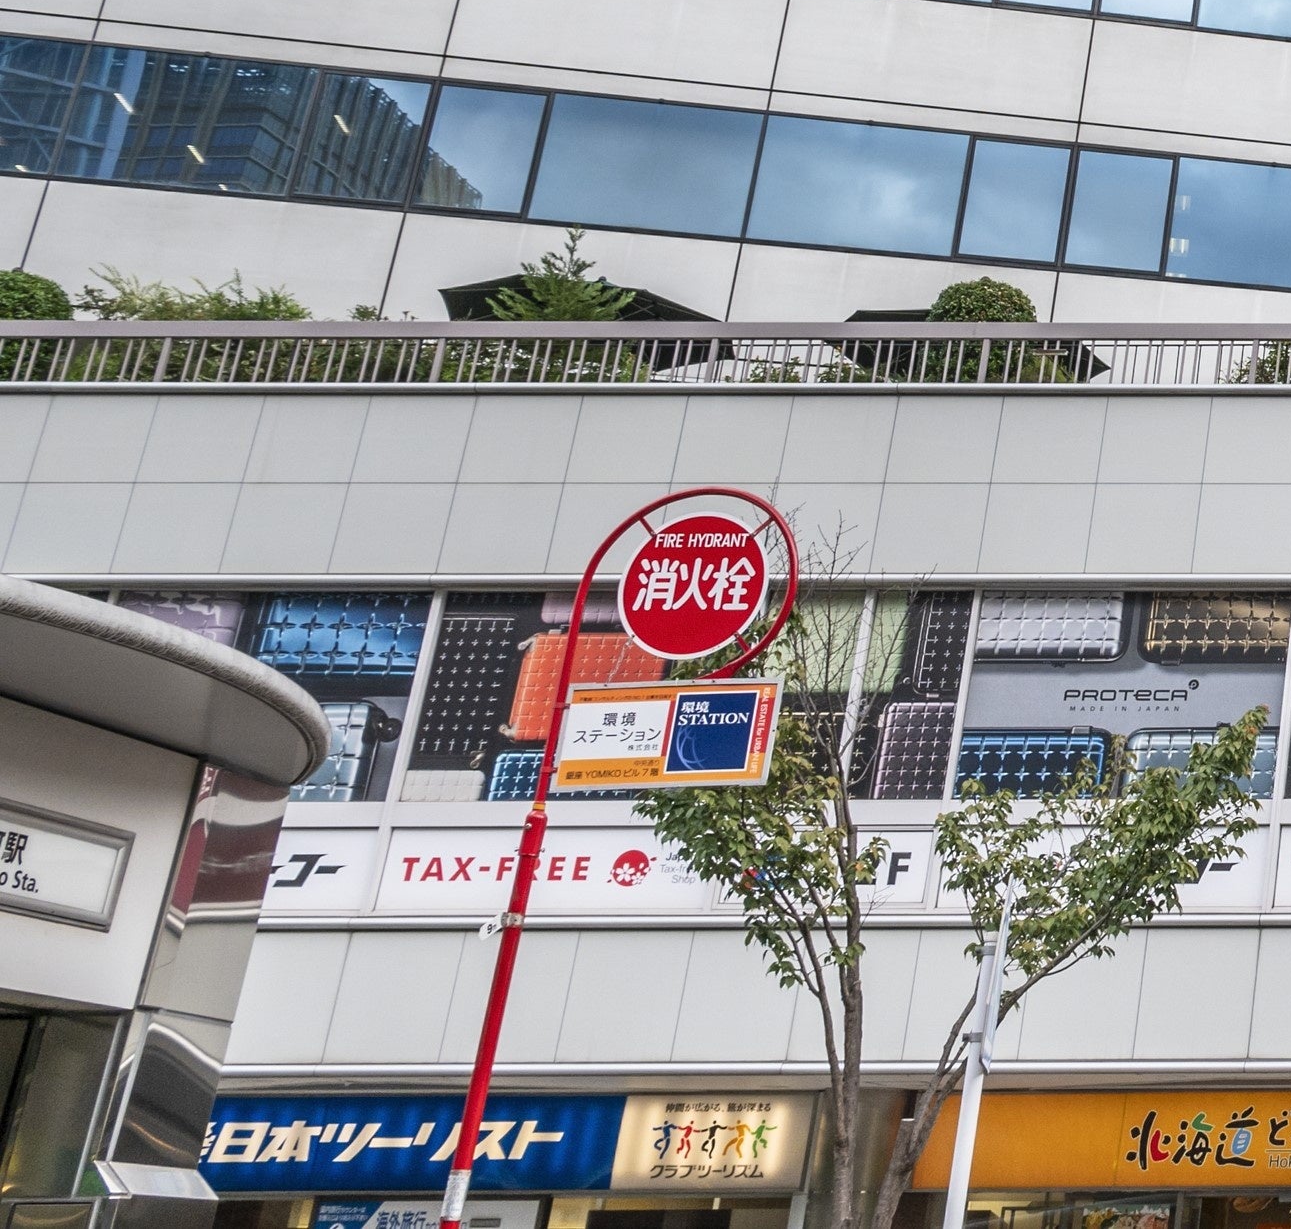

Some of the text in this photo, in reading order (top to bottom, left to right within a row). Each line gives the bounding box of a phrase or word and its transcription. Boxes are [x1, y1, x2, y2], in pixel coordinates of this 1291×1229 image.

[655, 533, 749, 548] FIRE HYDRANT
[632, 557, 756, 611] 消火栓
[602, 712, 636, 726] 環境
[678, 712, 750, 726] STATION
[573, 728, 662, 744] ステーション
[0, 831, 28, 865] 駅
[12, 870, 39, 893] Sta.
[671, 873, 696, 885] Shop
[199, 1120, 565, 1164] 日本ツーリスト
[1125, 1106, 1259, 1172] 北海道
[650, 1164, 764, 1179] クラブツーリズム
